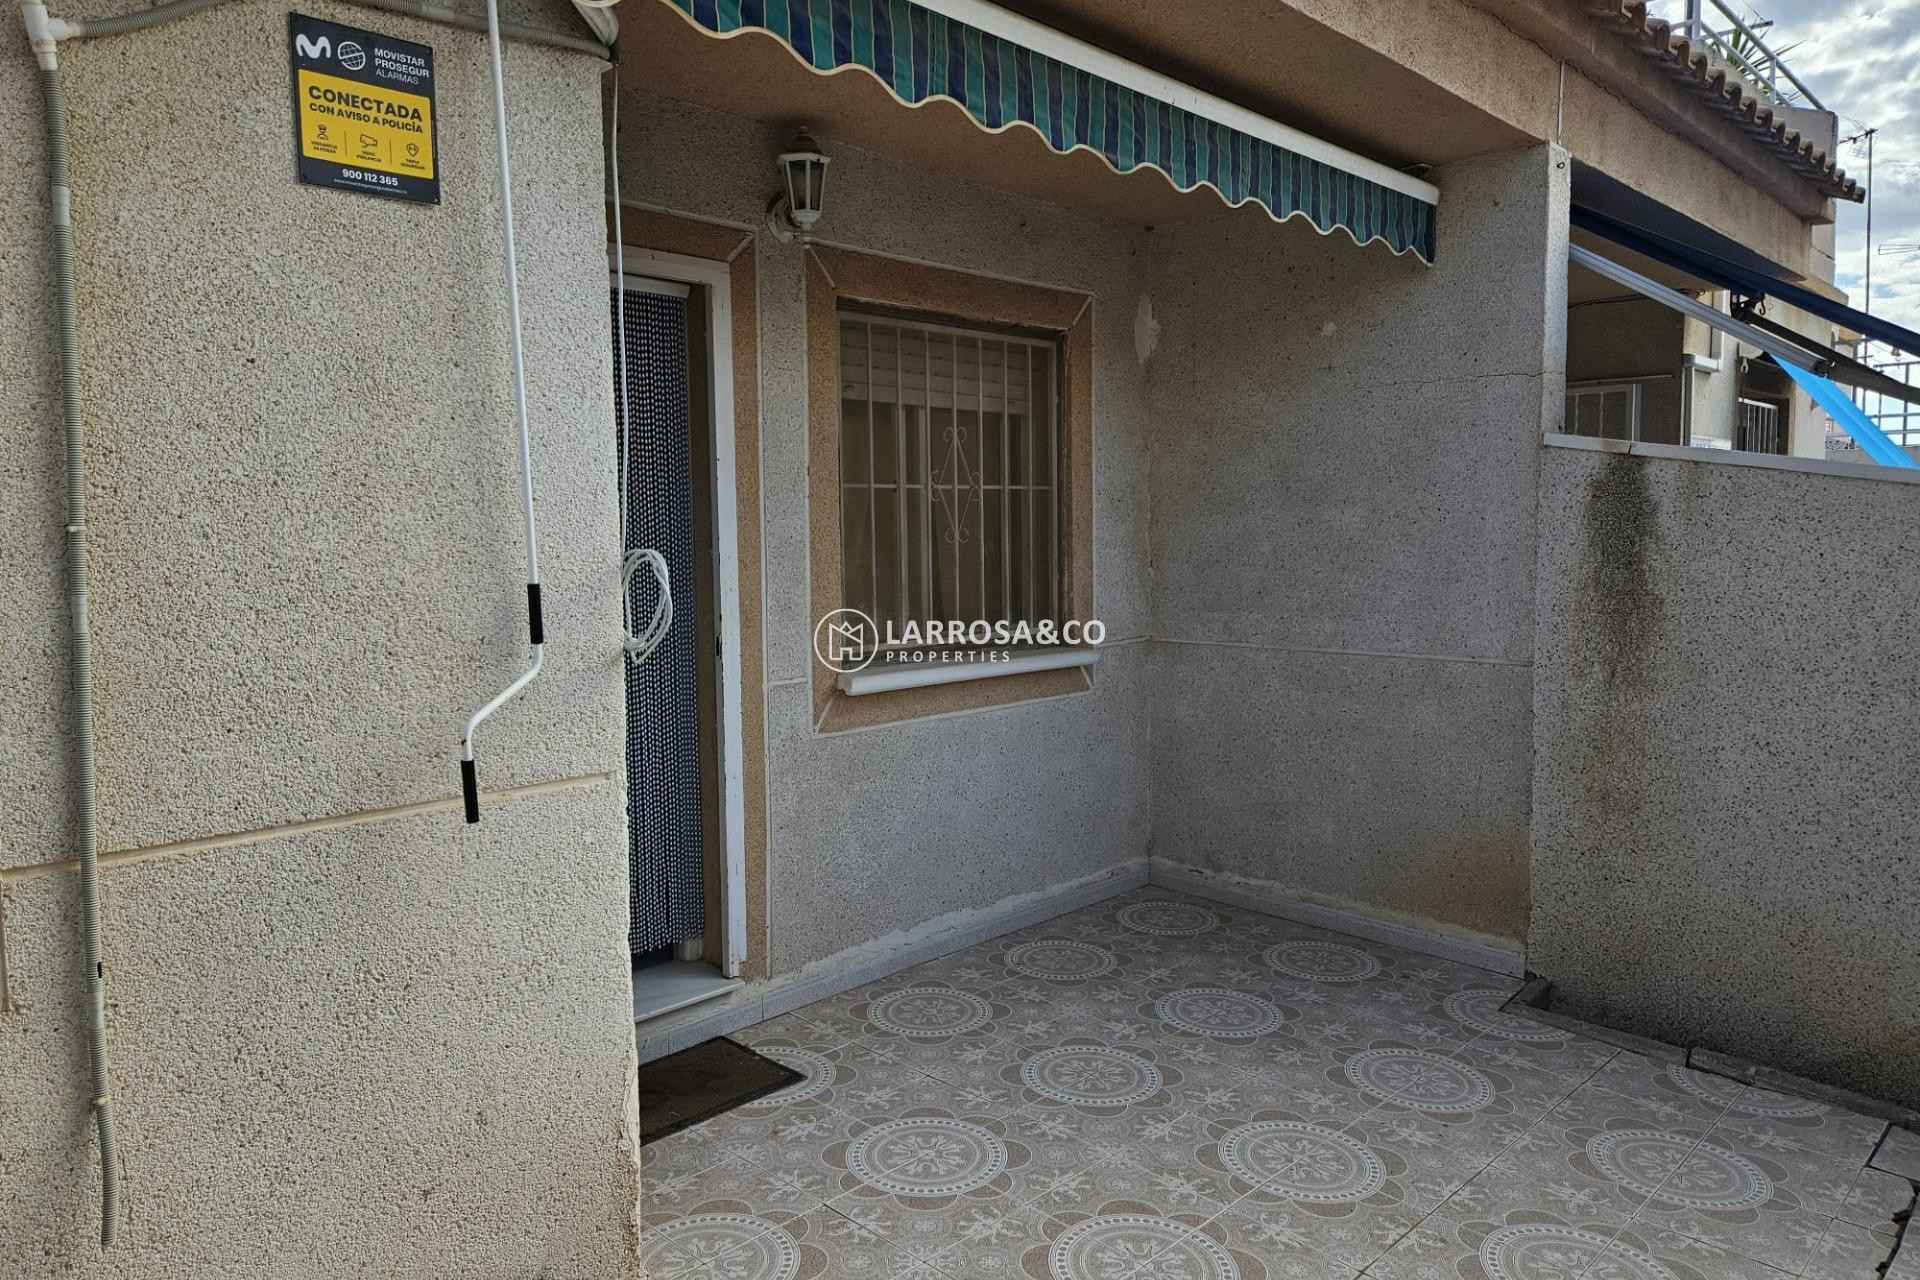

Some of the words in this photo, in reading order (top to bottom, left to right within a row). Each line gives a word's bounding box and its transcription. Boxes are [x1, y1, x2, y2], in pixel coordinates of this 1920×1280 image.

[374, 47, 425, 67] MOVISTAR
[375, 59, 430, 78] PROSEGUR
[376, 69, 420, 85] ALARMAS
[308, 85, 423, 122] CONECTADA
[309, 103, 335, 116] CON
[336, 109, 371, 124] AVISO
[373, 116, 381, 126] A
[382, 117, 423, 134] POLICÍA
[342, 168, 362, 181] 900
[363, 171, 378, 183] 112
[379, 174, 399, 186] 365
